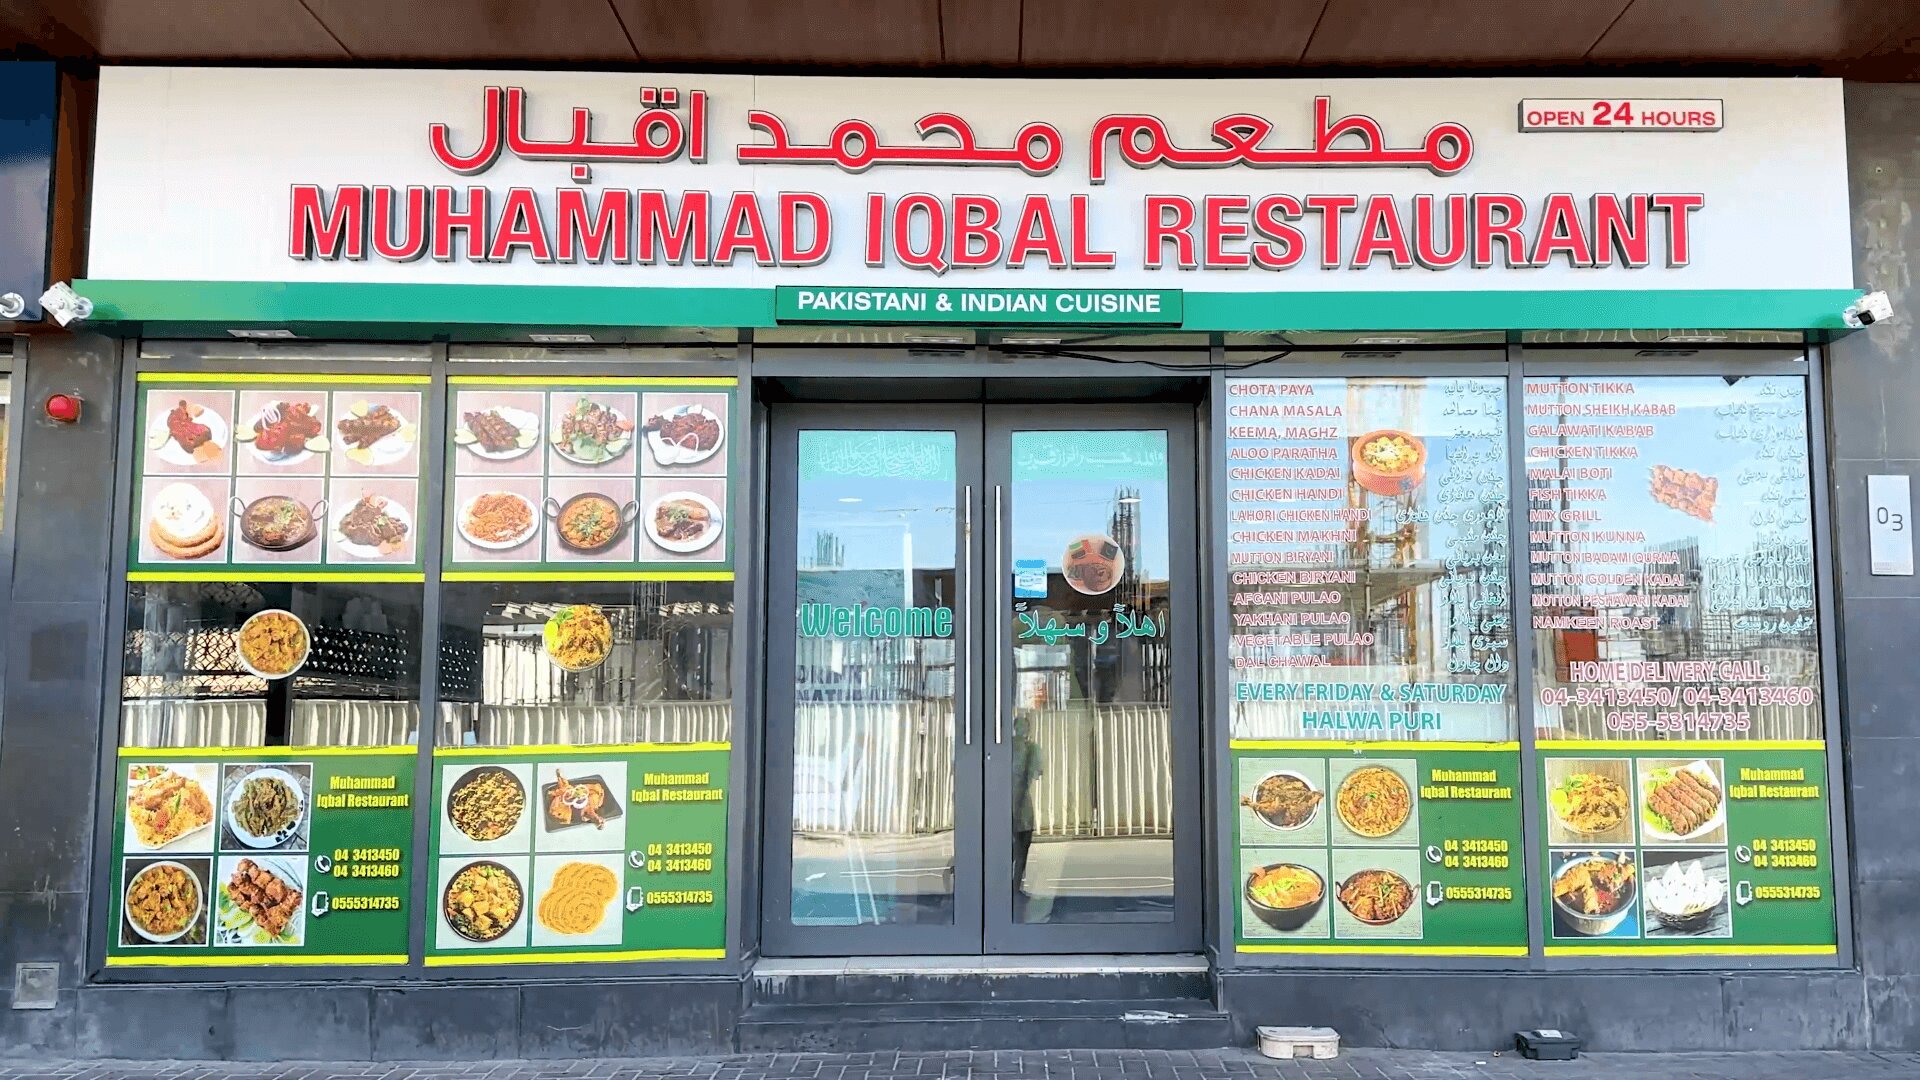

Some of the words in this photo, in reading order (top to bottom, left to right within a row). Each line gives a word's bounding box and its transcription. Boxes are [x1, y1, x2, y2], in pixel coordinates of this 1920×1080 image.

[1527, 111, 1584, 126] OPEN
[1593, 101, 1634, 126] 24
[1642, 111, 1716, 126] HOURS
[429, 86, 708, 184] اقبال
[1089, 95, 1475, 186] مطعم
[737, 110, 1064, 177] محمد
[289, 183, 833, 267] MUHAMMAD
[865, 191, 1116, 277] IQBAL
[1144, 193, 1704, 270] RESTAURANT
[798, 291, 927, 311] PAKISTANI
[935, 293, 953, 312] &
[961, 293, 1047, 312] INDIAN
[1055, 294, 1161, 313] CUISINE
[1229, 384, 1278, 396] CHOTA
[1280, 384, 1314, 396] PAYA
[1526, 383, 1589, 395] MUTTON
[1593, 383, 1635, 394] TIKKA
[1229, 405, 1279, 417] CHANA
[1283, 405, 1343, 417] MASALA
[1527, 404, 1582, 415] MUTTON
[1585, 404, 1630, 415] SHEIKH
[1633, 404, 1676, 415] KABAB
[1285, 427, 1338, 438] MAGHZ
[1528, 425, 1601, 436] GALAWATI
[1605, 425, 1654, 436] KABAB
[1231, 448, 1270, 459] ALOO
[1273, 448, 1338, 459] PARATHA
[1530, 446, 1593, 458] CHICKEN
[1597, 446, 1638, 458] TIKKA
[1231, 468, 1292, 480] CHICKEN
[1295, 467, 1341, 479] KADAI
[1529, 468, 1575, 479] MALAI
[1579, 467, 1613, 479] BOTI
[1231, 488, 1294, 500] CHICKEN
[1296, 488, 1344, 500] HANDI
[1529, 489, 1562, 500] FISH
[1564, 489, 1607, 500] TIKKA
[1231, 510, 1275, 521] LAHORI
[1278, 509, 1330, 521] CHICKEN
[1333, 508, 1372, 520] HANDI
[1529, 509, 1557, 522] MIX
[1560, 510, 1602, 522] GRILL
[1232, 530, 1294, 543] CHICKEN
[1298, 530, 1357, 542] MAKHNI
[1530, 531, 1590, 543] MUTTON
[1595, 531, 1646, 542] KUNNA
[1232, 552, 1282, 563] MUTTON
[1286, 551, 1334, 562] BIRYANI
[1530, 551, 1581, 564] MUTTON
[1583, 551, 1632, 564] BADAMI
[1634, 551, 1680, 564] QURMA
[1232, 571, 1297, 584] CHICKEN
[1300, 571, 1356, 583] BIRYANI
[1531, 573, 1584, 585] MUTTON
[1587, 573, 1641, 585] GOLDEN
[1644, 573, 1685, 586] KADAI
[1233, 592, 1289, 605] AFGANI
[1291, 591, 1341, 604] PULAO
[1583, 594, 1650, 607] PESHAWARI
[1652, 594, 1689, 607] KADAI
[801, 603, 953, 638] Welcome
[1233, 613, 1297, 626] YAKHANI
[1301, 612, 1350, 625] PULAO
[1533, 616, 1605, 629] NAMKEEN
[1609, 616, 1661, 629] ROAST
[1235, 634, 1320, 647] VEGETABLE
[1324, 633, 1374, 646] PULAO
[1234, 656, 1265, 668] DAL
[1267, 655, 1332, 668] CHAWAL
[1570, 662, 1625, 682] HOME
[1628, 662, 1714, 682] DELIVERY
[1718, 661, 1770, 681] CALL:
[1236, 683, 1299, 701] EVERY
[1304, 683, 1374, 702] FRIDAY
[1380, 683, 1395, 701] &
[1400, 682, 1507, 703] SATURDAY
[1540, 687, 1680, 708] 04-3413450/
[1683, 686, 1814, 707] 04-3413460
[1302, 711, 1383, 730] HALWA
[1390, 711, 1441, 730] PURI
[1607, 712, 1751, 732] 055-5314735
[644, 772, 710, 785] Muhammad
[1431, 769, 1497, 782] Muhammad
[1740, 767, 1805, 781] Muhammad
[330, 776, 395, 789] Muhammad
[631, 789, 660, 803] Iqbal
[662, 788, 723, 801] Restaurant
[1420, 786, 1449, 799] Iqbal
[1451, 786, 1512, 799] Restaurant
[1729, 784, 1758, 799] Iqbal
[1759, 785, 1819, 798] Restaurant
[317, 794, 345, 809] Iqbal
[347, 794, 409, 807] Restaurant
[648, 843, 662, 856] 04
[666, 843, 712, 855] 3413450
[1444, 839, 1458, 852] 04
[1462, 839, 1508, 852] 3413450
[1752, 839, 1767, 852] 04
[1771, 839, 1816, 852] 3413450
[334, 849, 348, 861] 04
[353, 849, 400, 861] 3413450
[1444, 855, 1459, 868] 04
[1463, 855, 1509, 868] 3413460
[1753, 854, 1768, 867] 04
[1771, 854, 1817, 867] 3413460
[333, 865, 348, 878] 04
[352, 865, 399, 878] 3413460
[647, 859, 661, 872] 04
[666, 858, 711, 871] 3413460
[646, 891, 713, 904] 0555314735
[1446, 887, 1512, 900] 0555314735
[1755, 886, 1821, 899] 0555314735
[332, 897, 399, 910] 0555314735
